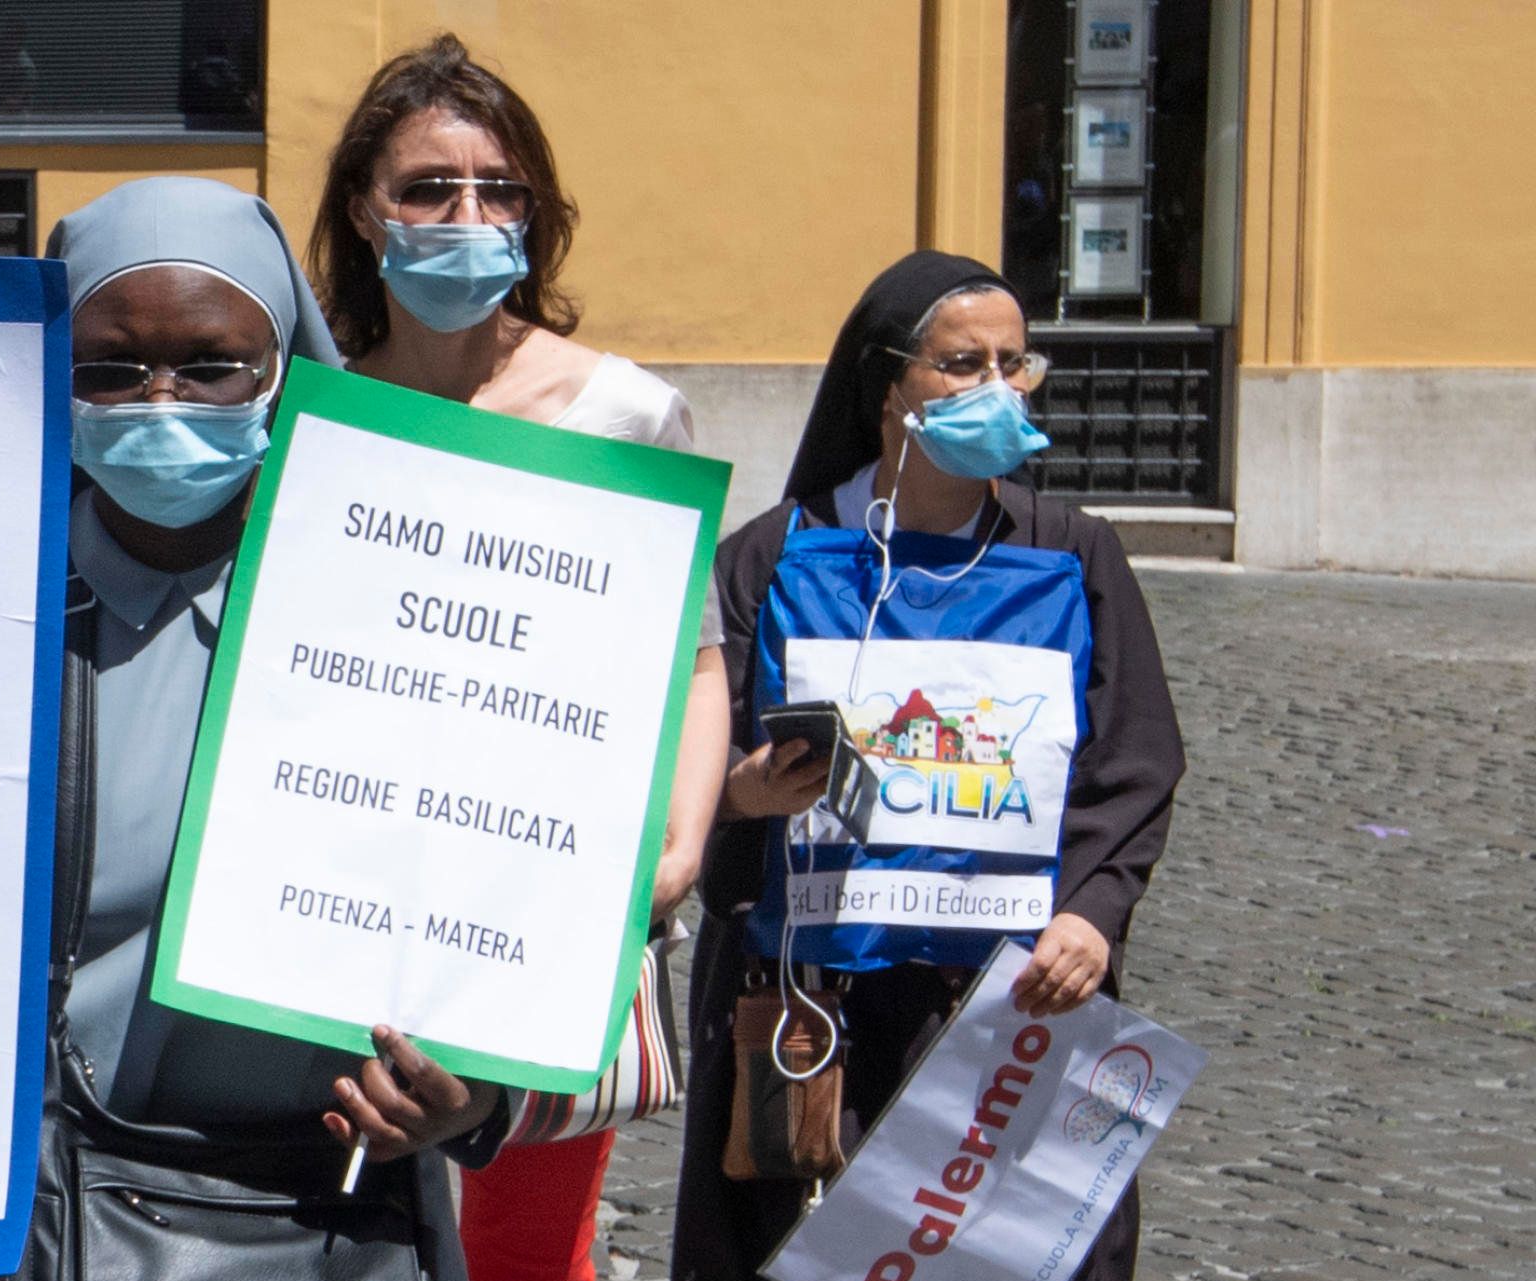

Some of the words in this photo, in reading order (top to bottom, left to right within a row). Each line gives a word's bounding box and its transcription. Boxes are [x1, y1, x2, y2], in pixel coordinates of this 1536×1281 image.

[344, 502, 445, 557] SIAMO
[463, 530, 611, 596] INVISIBILI
[396, 591, 533, 652] SCUOLE
[290, 643, 609, 742] PUBBLICHE-PARITARIE
[274, 760, 399, 812] REGIONE
[415, 787, 577, 855] BASILICATA
[878, 768, 1034, 825] CILIA
[279, 884, 392, 935] POTENZA
[425, 913, 525, 966] MATERA
[1073, 1138, 1133, 1224] PARITARIA
[1137, 1075, 1169, 1118] CIM
